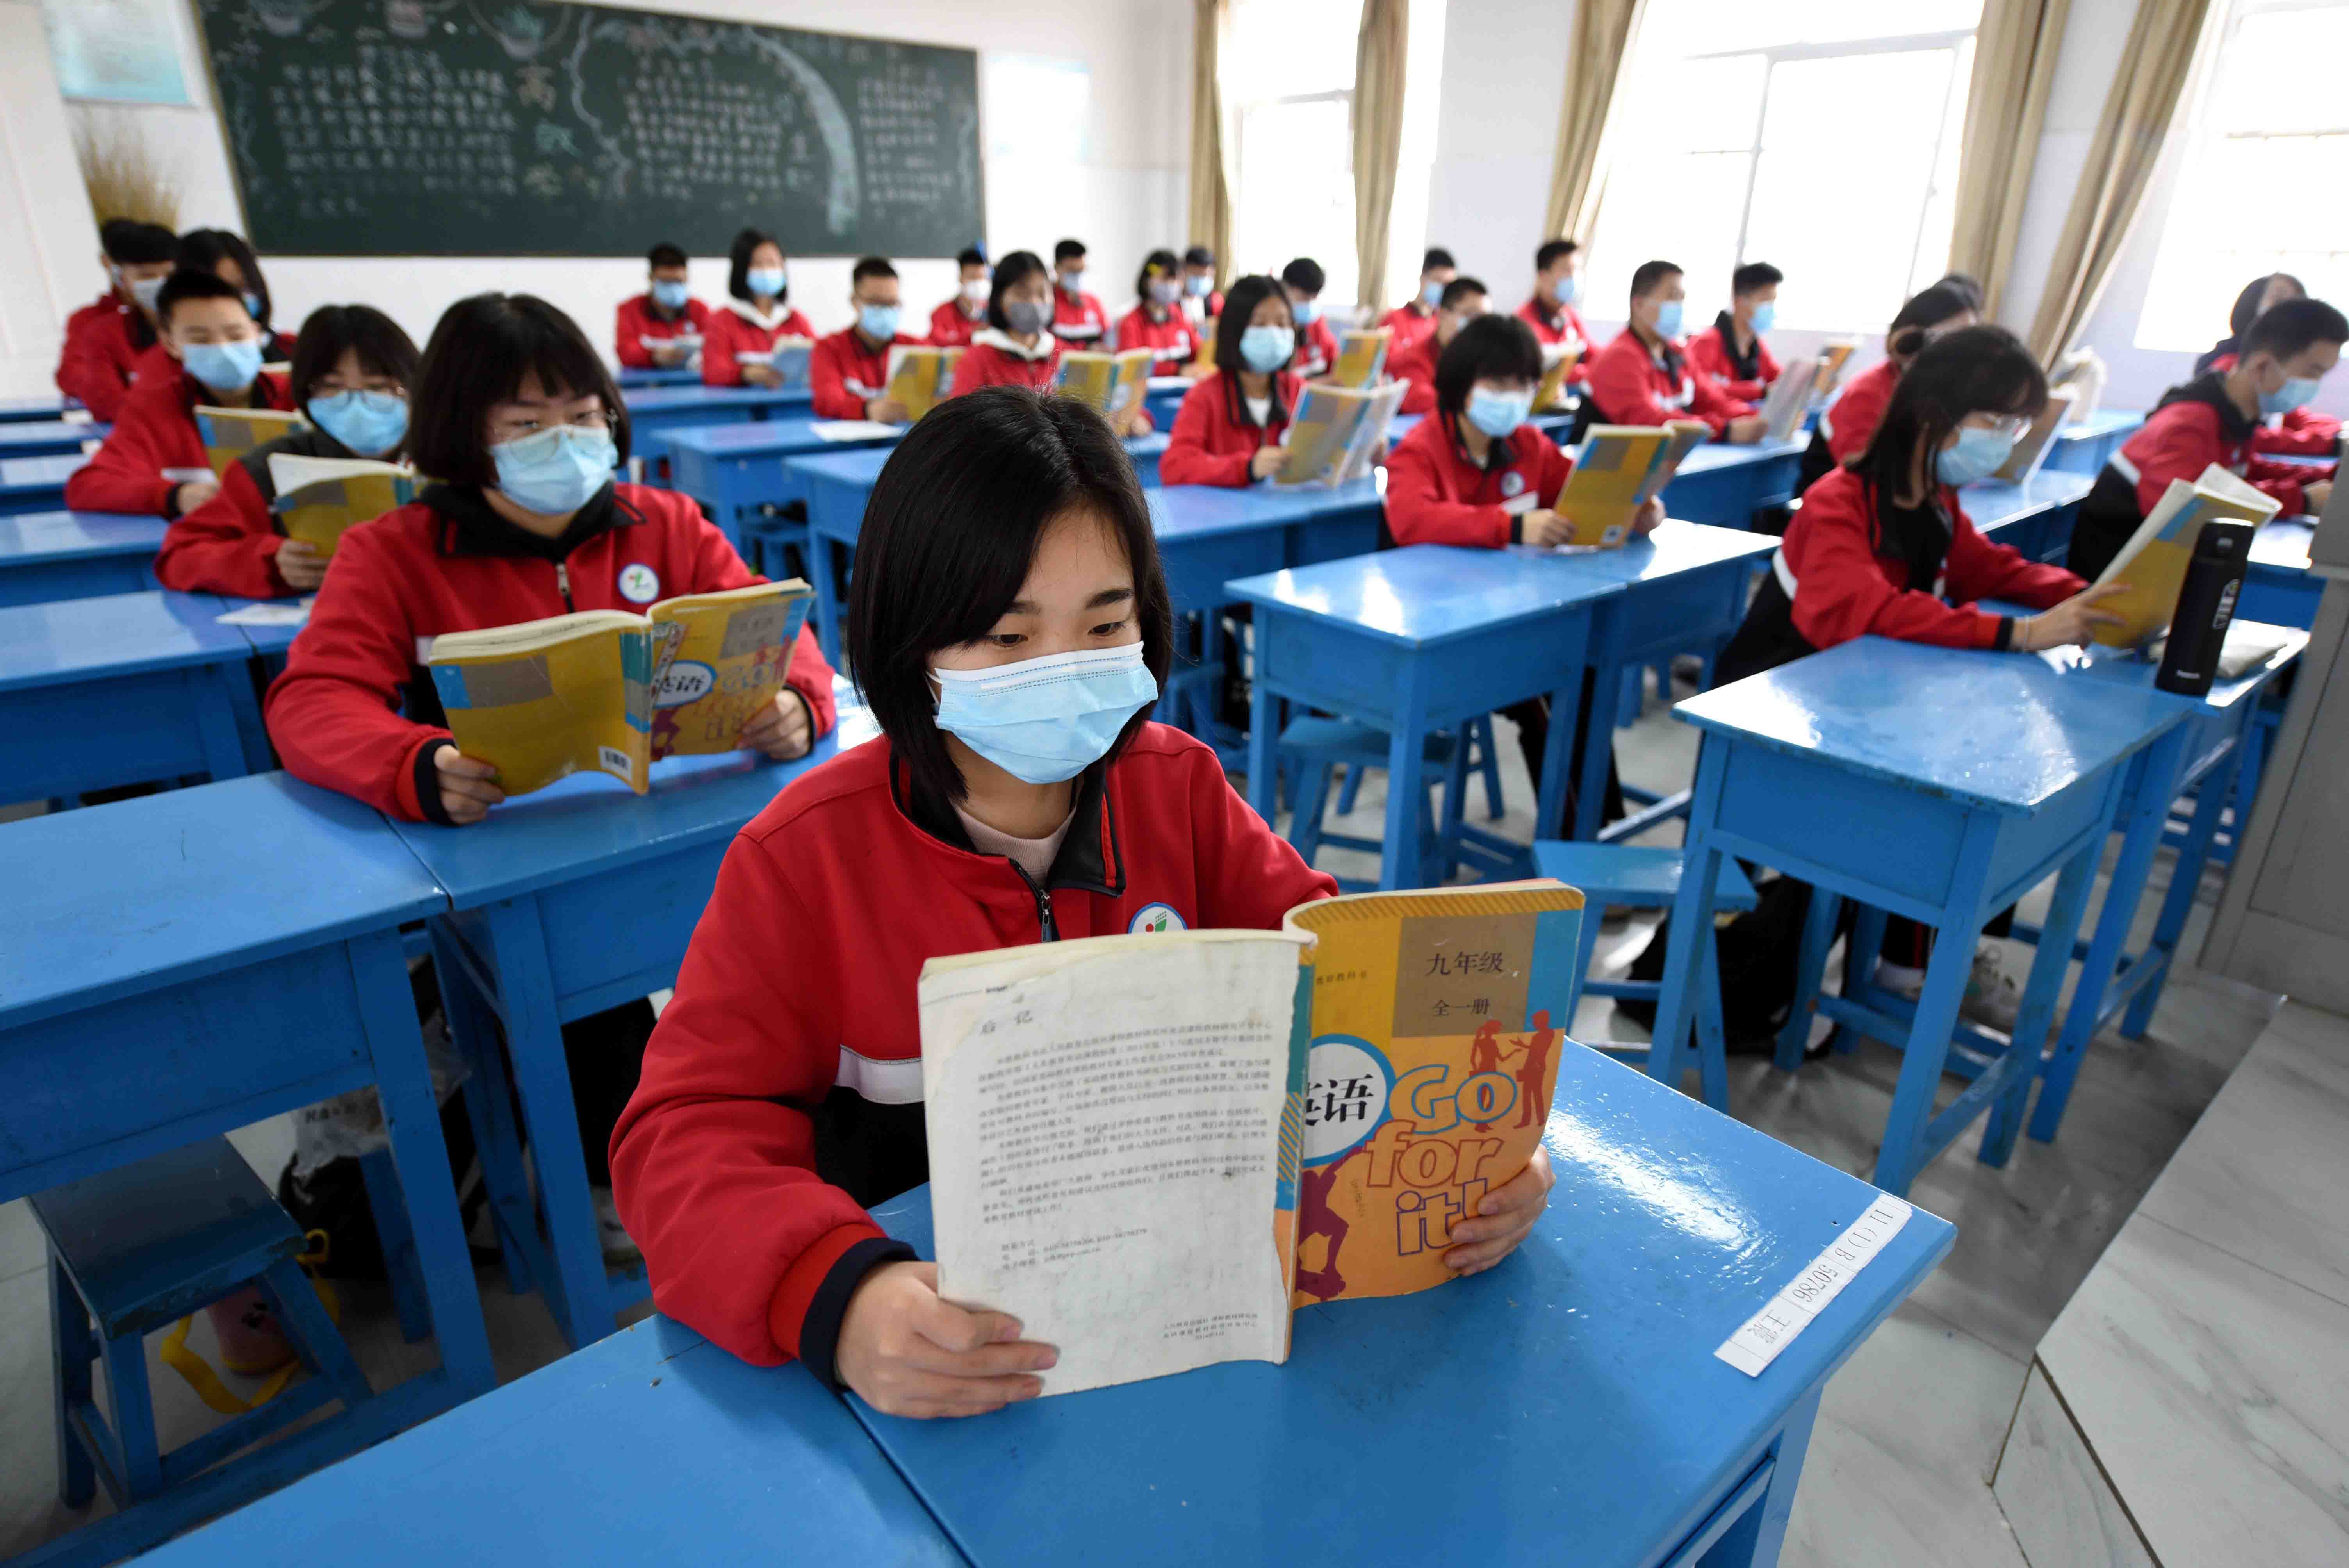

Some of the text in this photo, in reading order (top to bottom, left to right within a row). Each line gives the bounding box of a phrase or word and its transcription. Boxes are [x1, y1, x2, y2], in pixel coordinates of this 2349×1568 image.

[1424, 950, 1506, 976] 九年级
[1431, 998, 1490, 1017] 全一册
[1365, 1119, 1504, 1188] for
[1793, 1264, 1839, 1303] 50786
